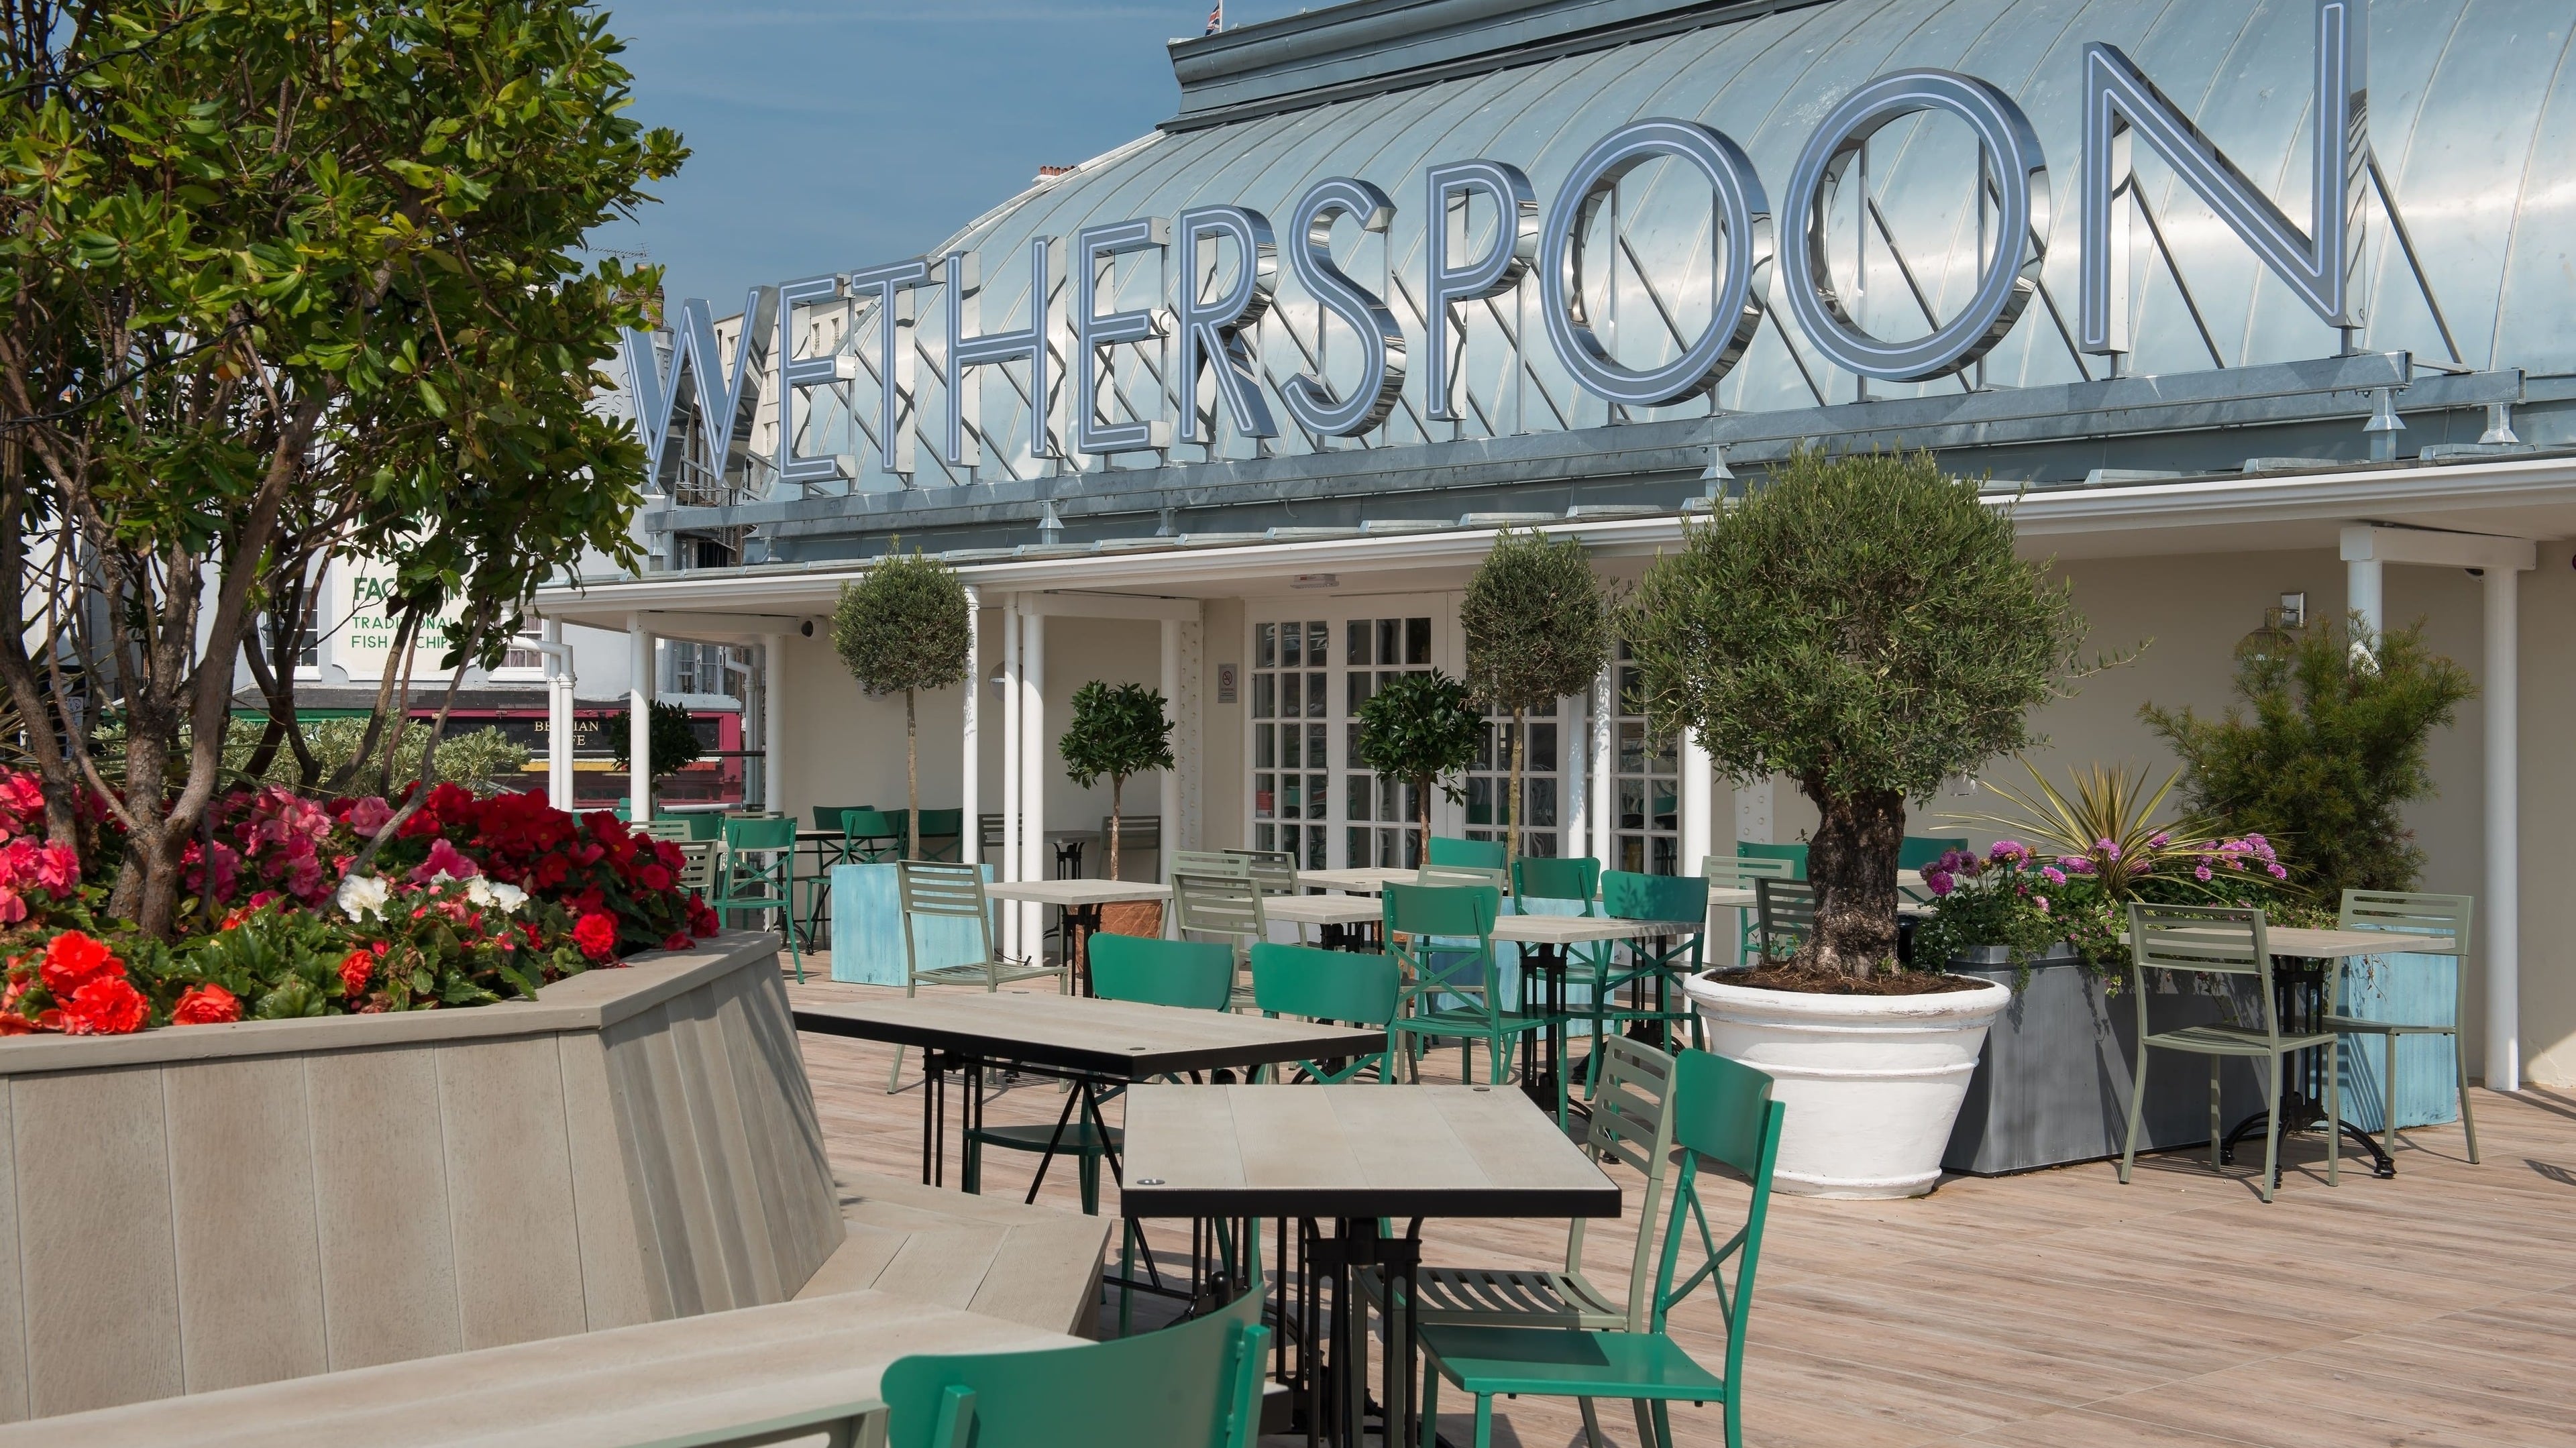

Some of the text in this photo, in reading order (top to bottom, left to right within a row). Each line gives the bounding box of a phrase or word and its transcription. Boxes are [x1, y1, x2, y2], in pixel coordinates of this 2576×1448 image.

[619, 0, 2368, 488] WETHERSPOON
[352, 616, 452, 629] TRADIONA
[352, 635, 448, 649] FISH CHIP
[534, 721, 599, 732] BEIAN
